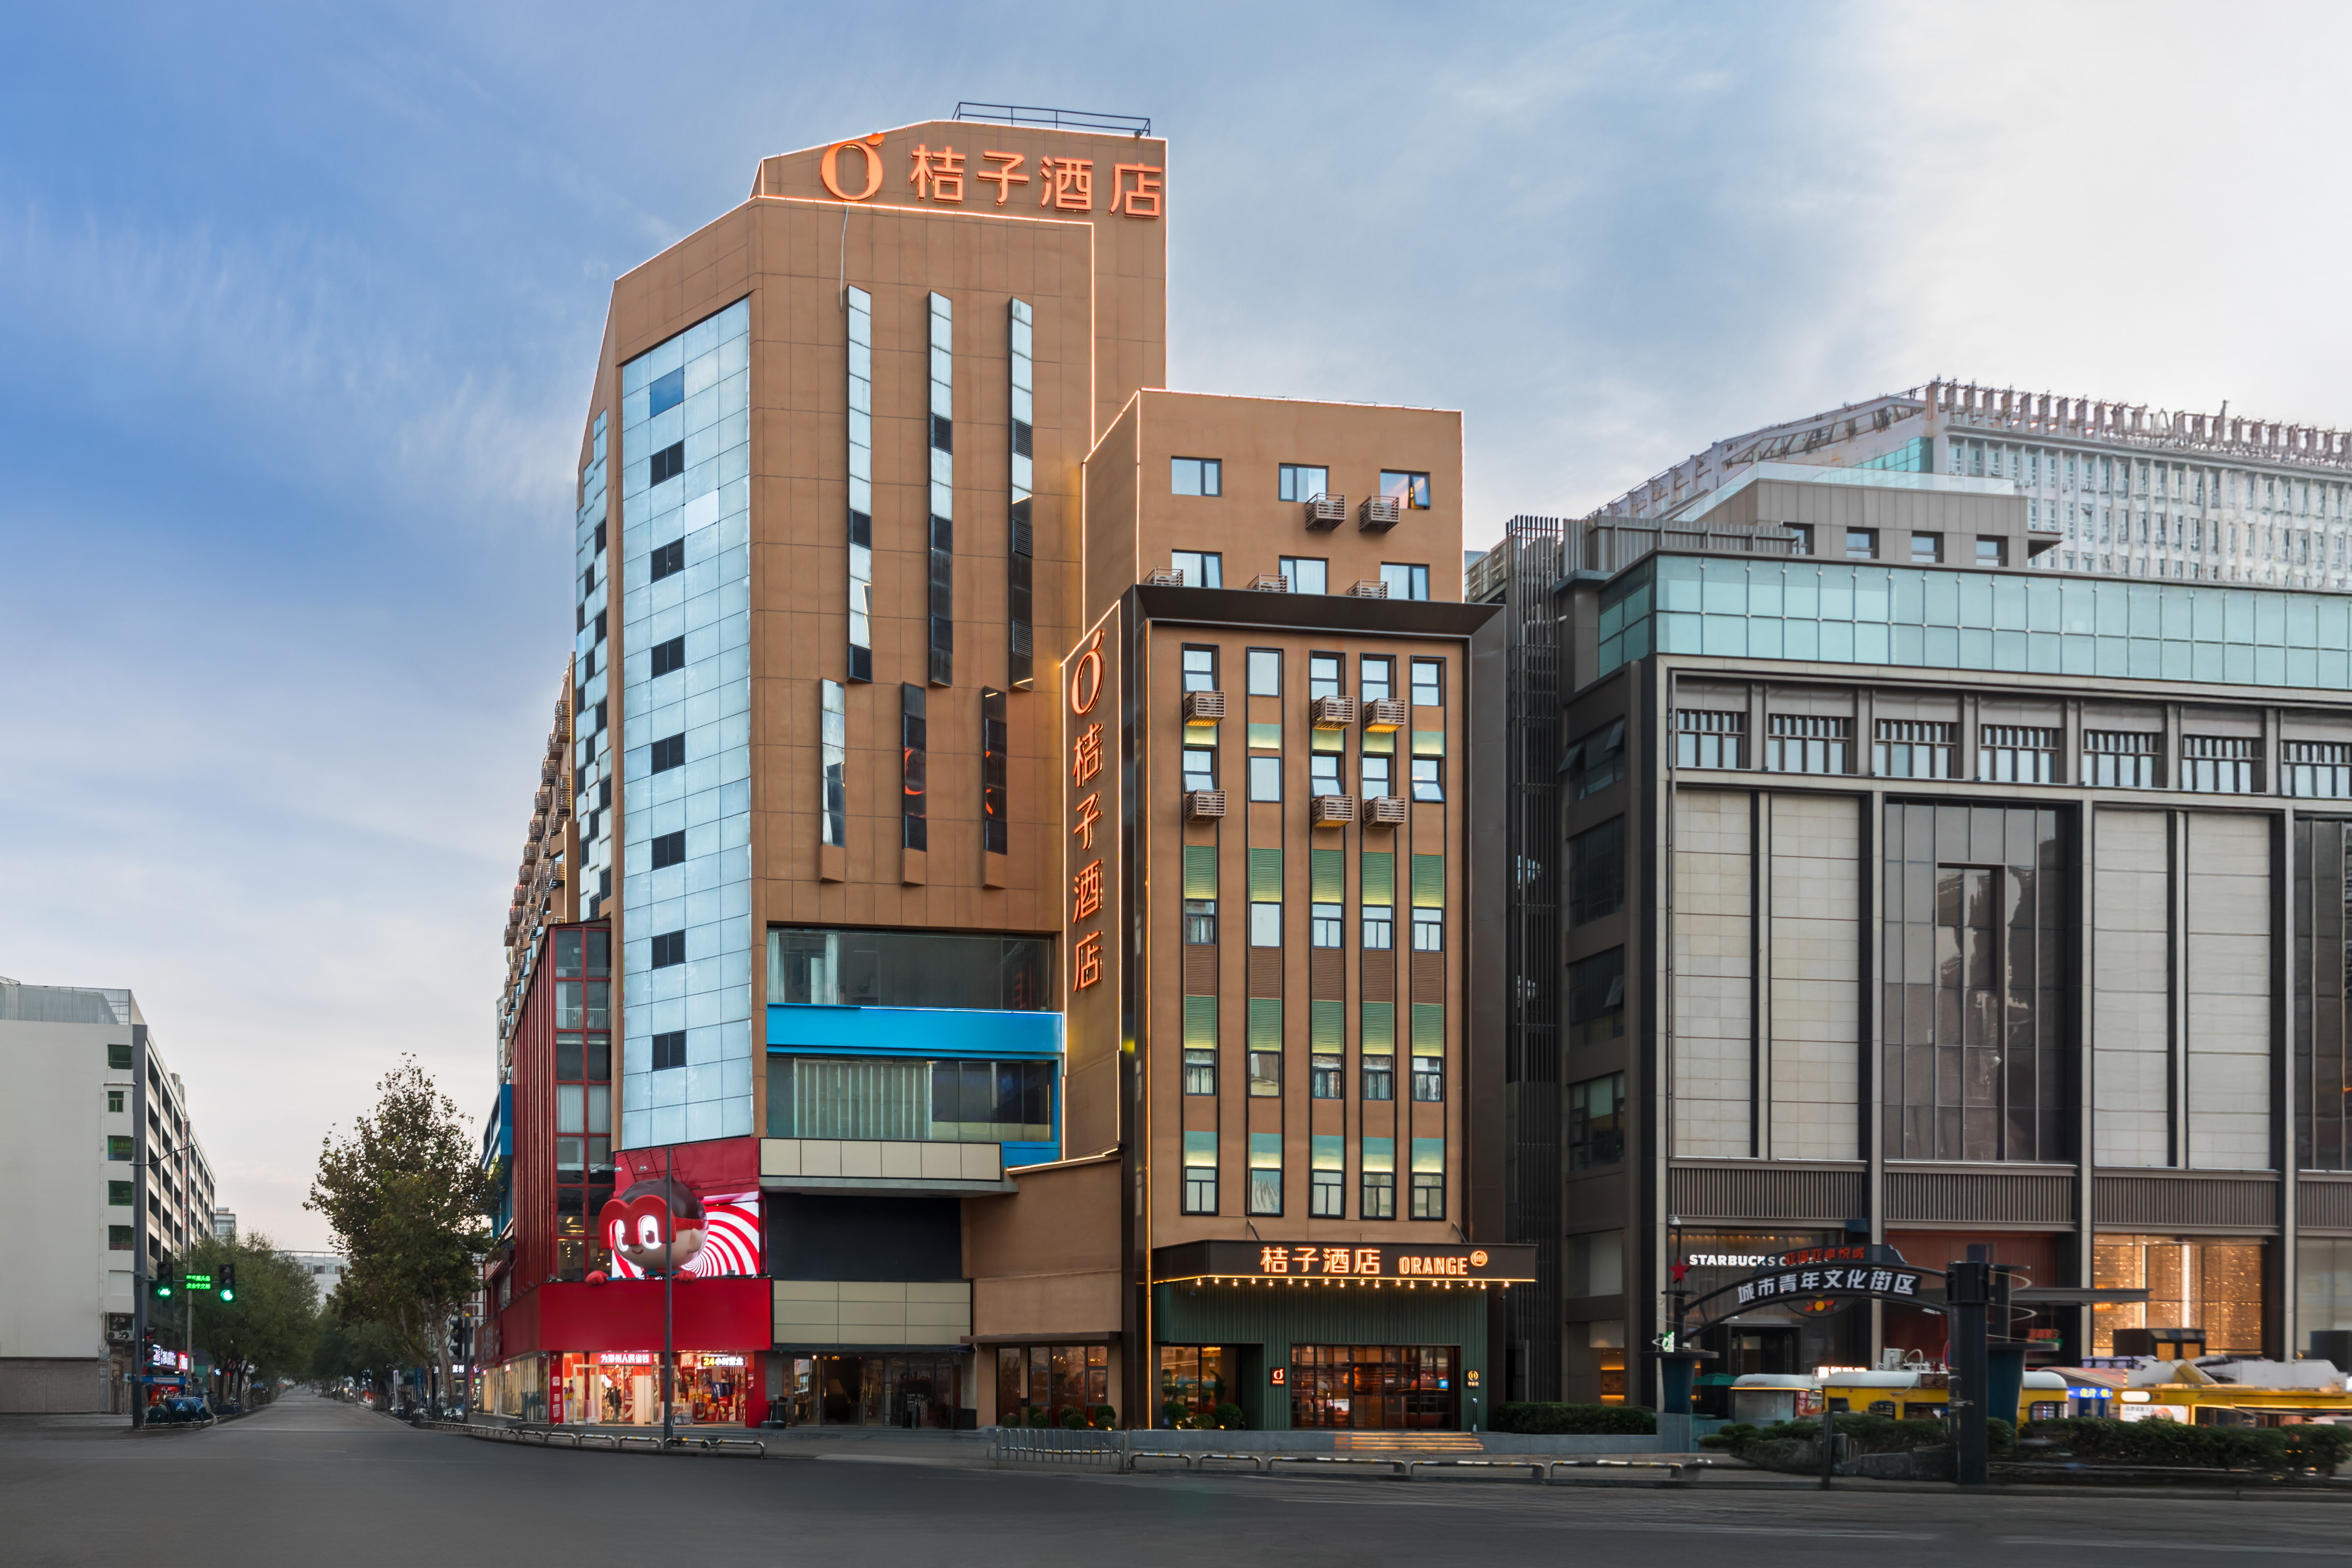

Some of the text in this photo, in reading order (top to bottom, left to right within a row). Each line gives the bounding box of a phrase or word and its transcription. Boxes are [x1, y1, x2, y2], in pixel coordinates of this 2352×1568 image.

[909, 144, 1162, 219] 桔子酒店
[1073, 723, 1103, 993] 桔子酒店
[1260, 1246, 1381, 1274] 桔子酒店
[1399, 1256, 1468, 1275] ORANGE
[1689, 1254, 1776, 1267] STARBUCKS
[1738, 1269, 1916, 1303] 城市青年文化街区
